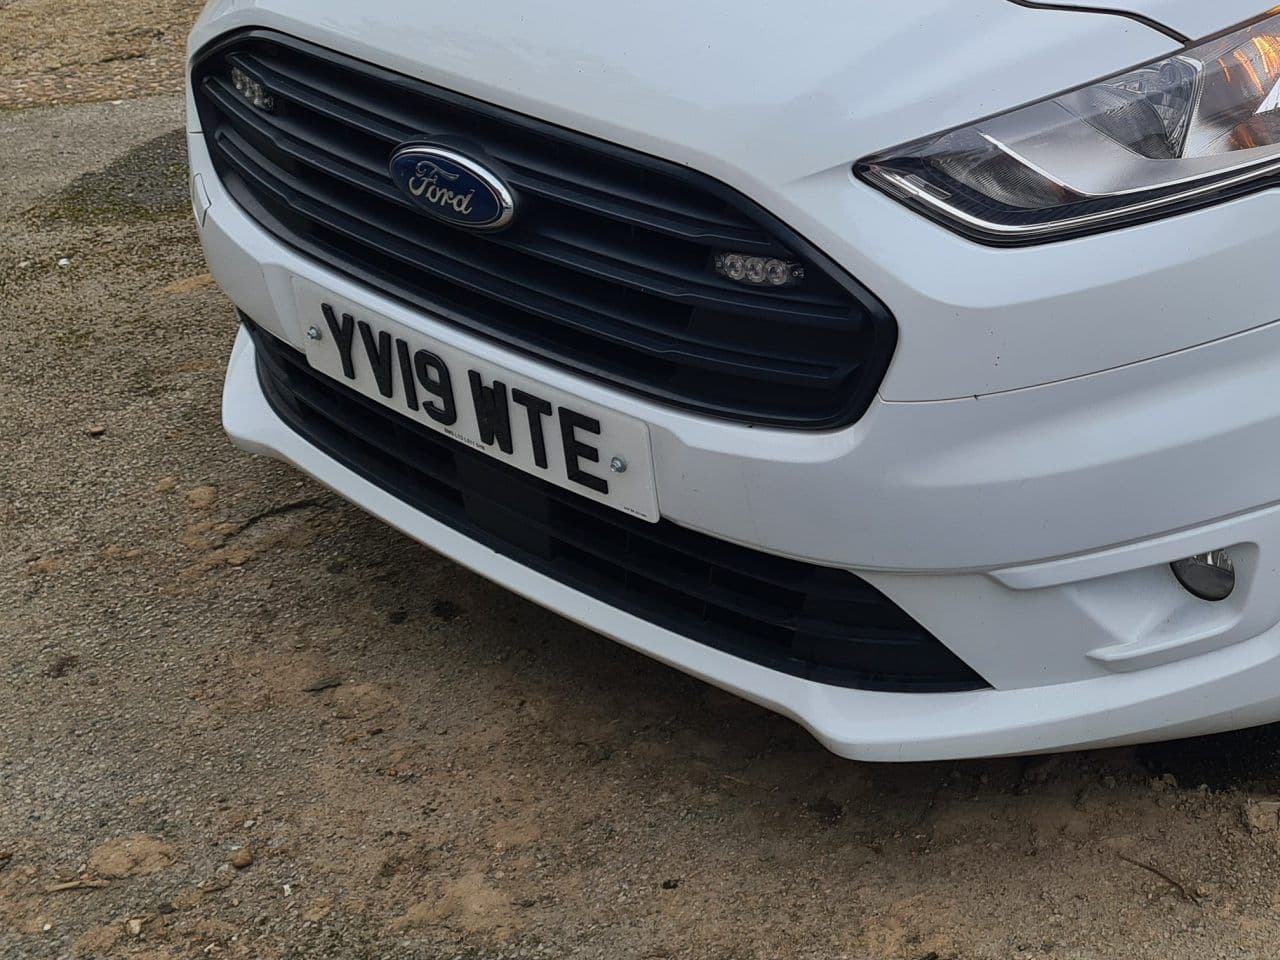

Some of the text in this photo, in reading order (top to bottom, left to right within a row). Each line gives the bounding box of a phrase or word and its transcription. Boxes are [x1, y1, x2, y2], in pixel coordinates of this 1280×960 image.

[408, 159, 475, 216] Ford
[321, 302, 610, 496] YV19 WTE
